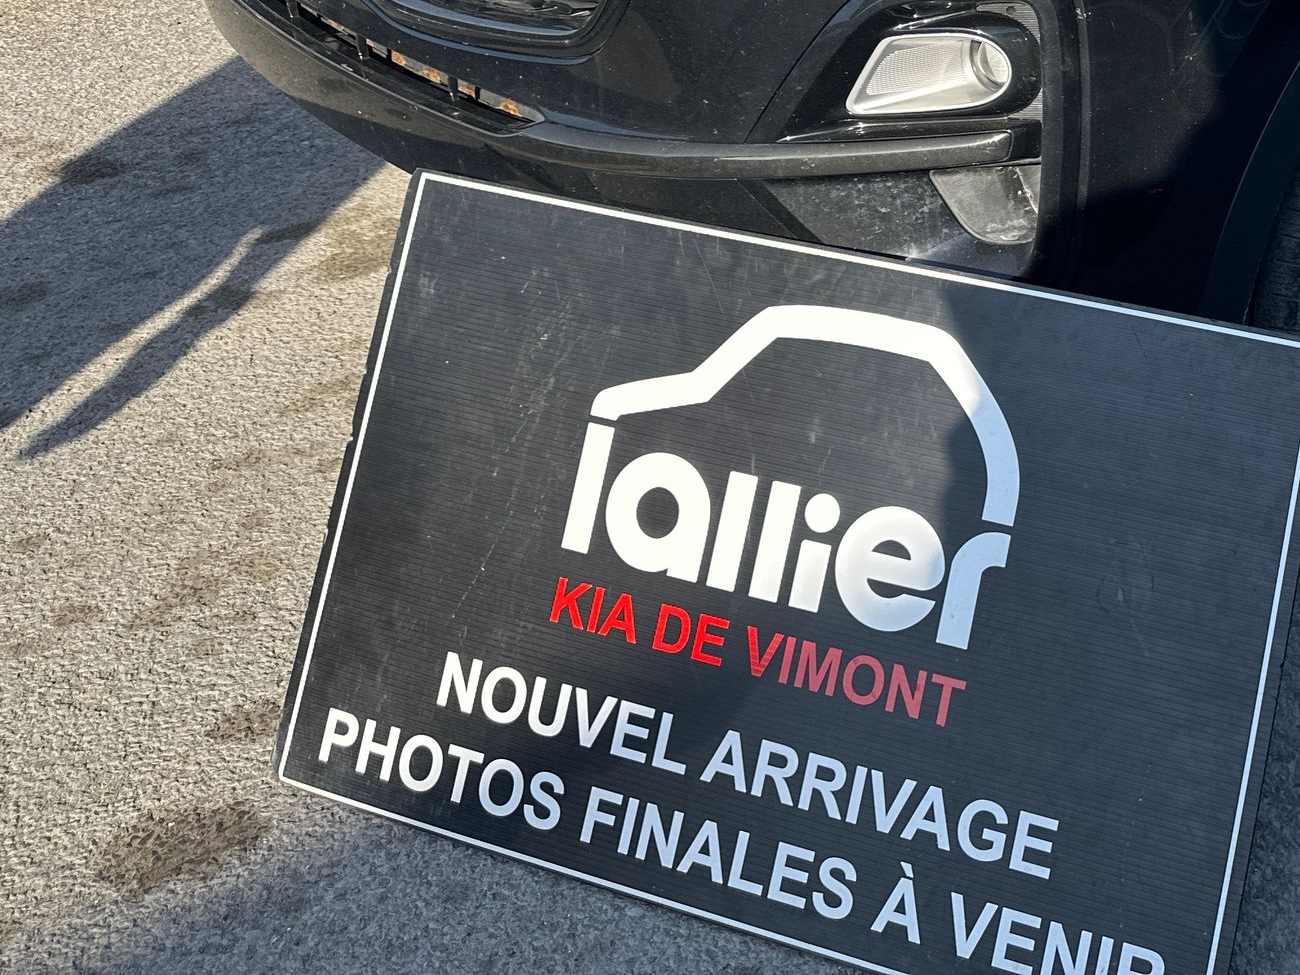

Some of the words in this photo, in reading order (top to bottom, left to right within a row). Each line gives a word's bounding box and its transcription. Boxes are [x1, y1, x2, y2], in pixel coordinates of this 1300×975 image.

[435, 650, 687, 776] NOUVEL
[699, 729, 1060, 881] ARRIVAGE
[549, 576, 638, 645] KIA
[652, 603, 731, 667] DE
[746, 625, 968, 728] VIMONT
[317, 706, 566, 831] PHOTOS
[578, 785, 858, 921] FINALES
[869, 861, 922, 945] À
